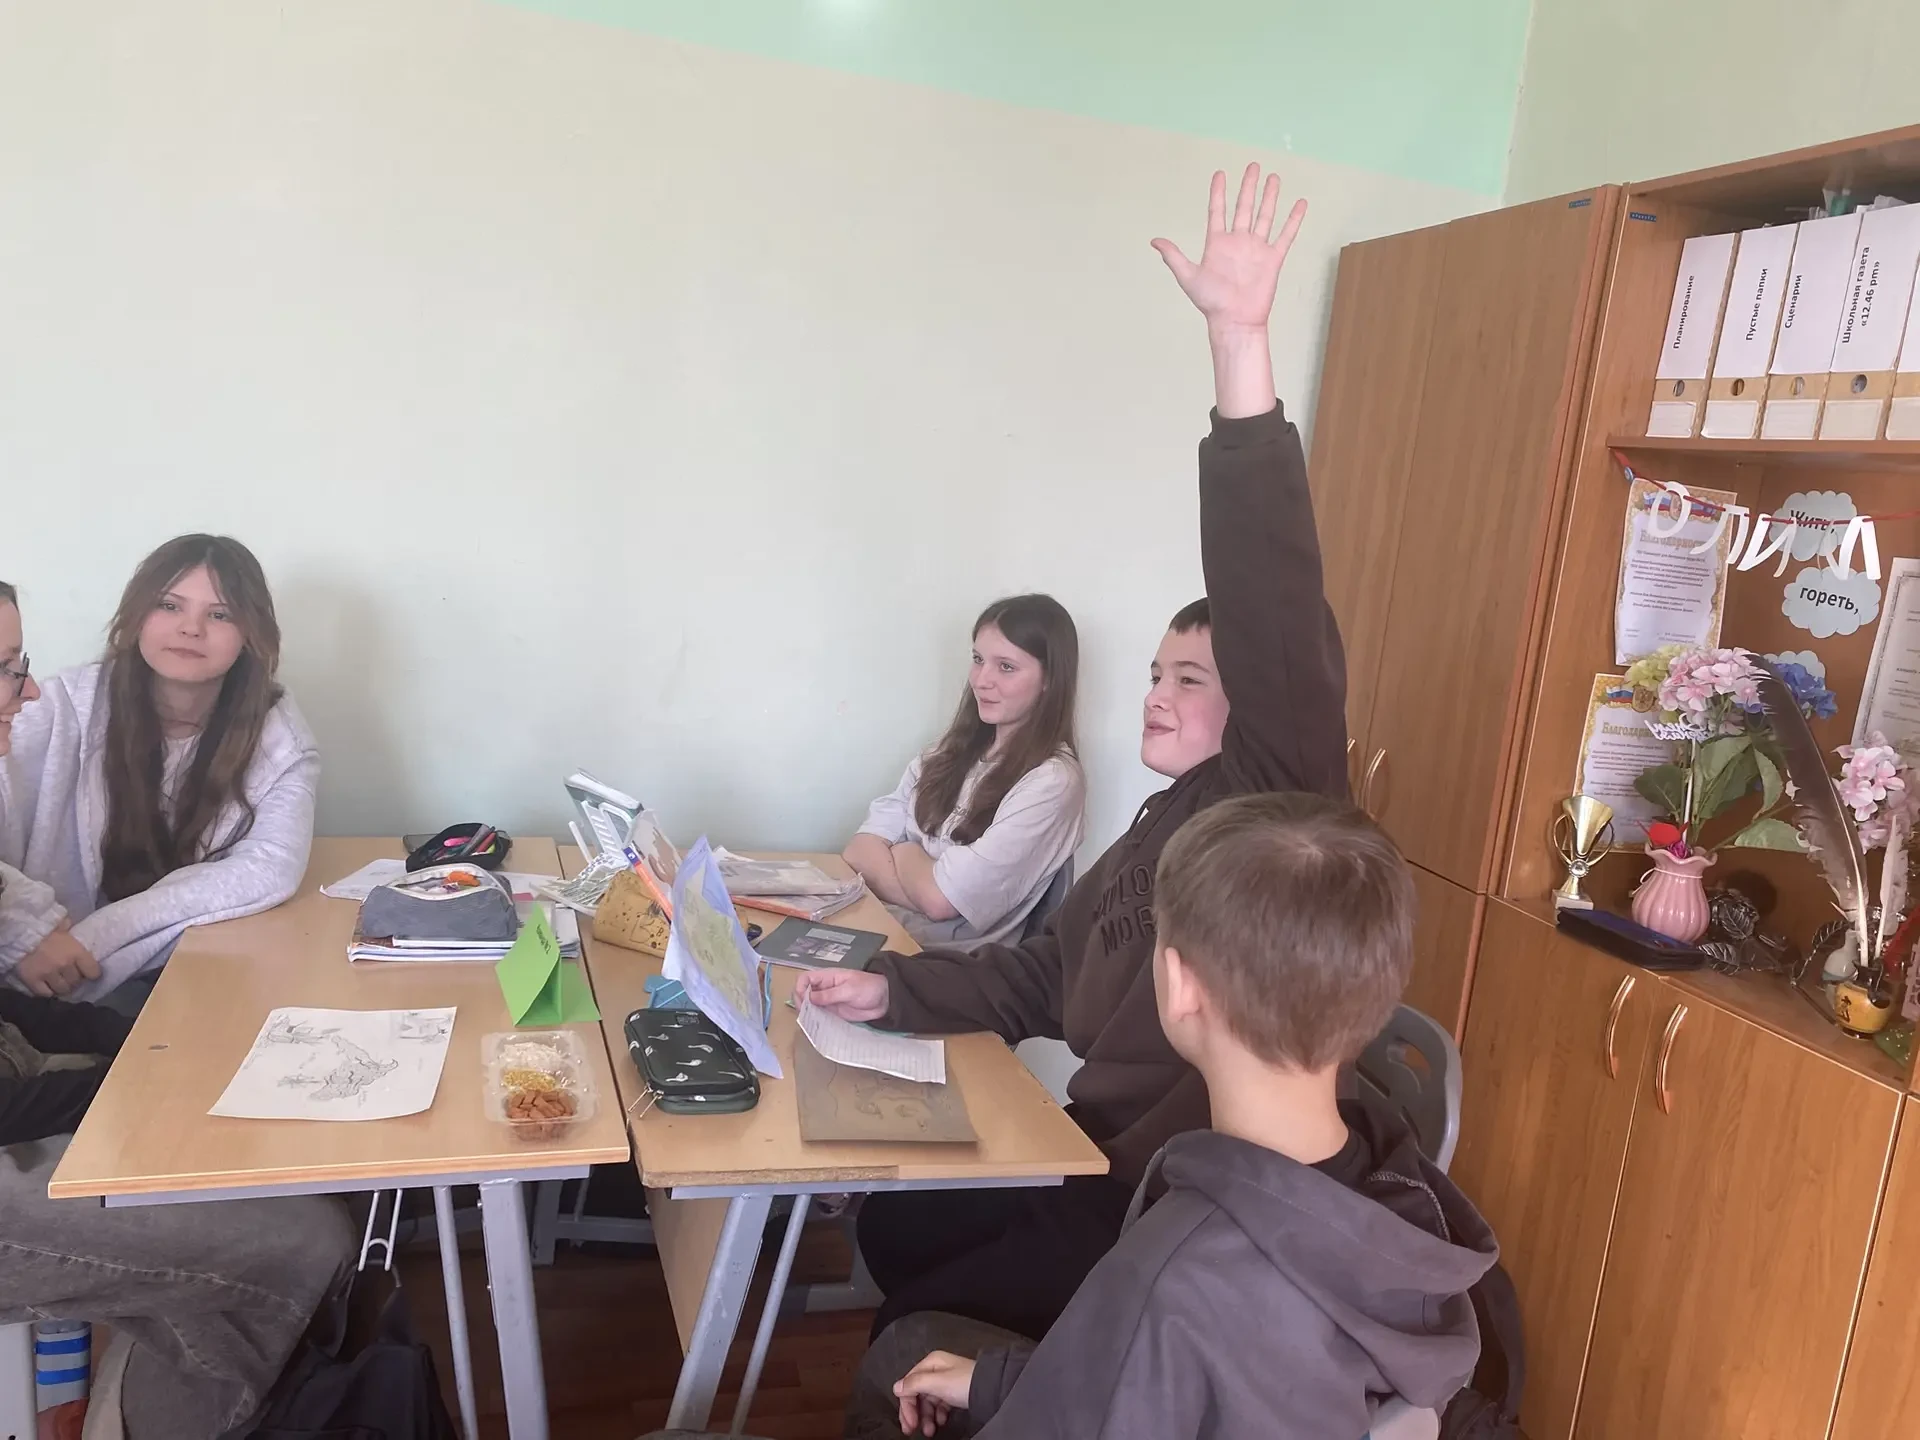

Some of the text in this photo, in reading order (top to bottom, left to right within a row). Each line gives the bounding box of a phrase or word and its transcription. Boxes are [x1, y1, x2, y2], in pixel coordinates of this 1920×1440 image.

[1673, 275, 1695, 349] Планирование
[1745, 268, 1768, 341] Пустые папки
[1784, 274, 1802, 329] Сценарии
[1842, 246, 1870, 343] Школьная газета
[1861, 289, 1875, 327] «12.46
[1799, 586, 1859, 615] гореть,
